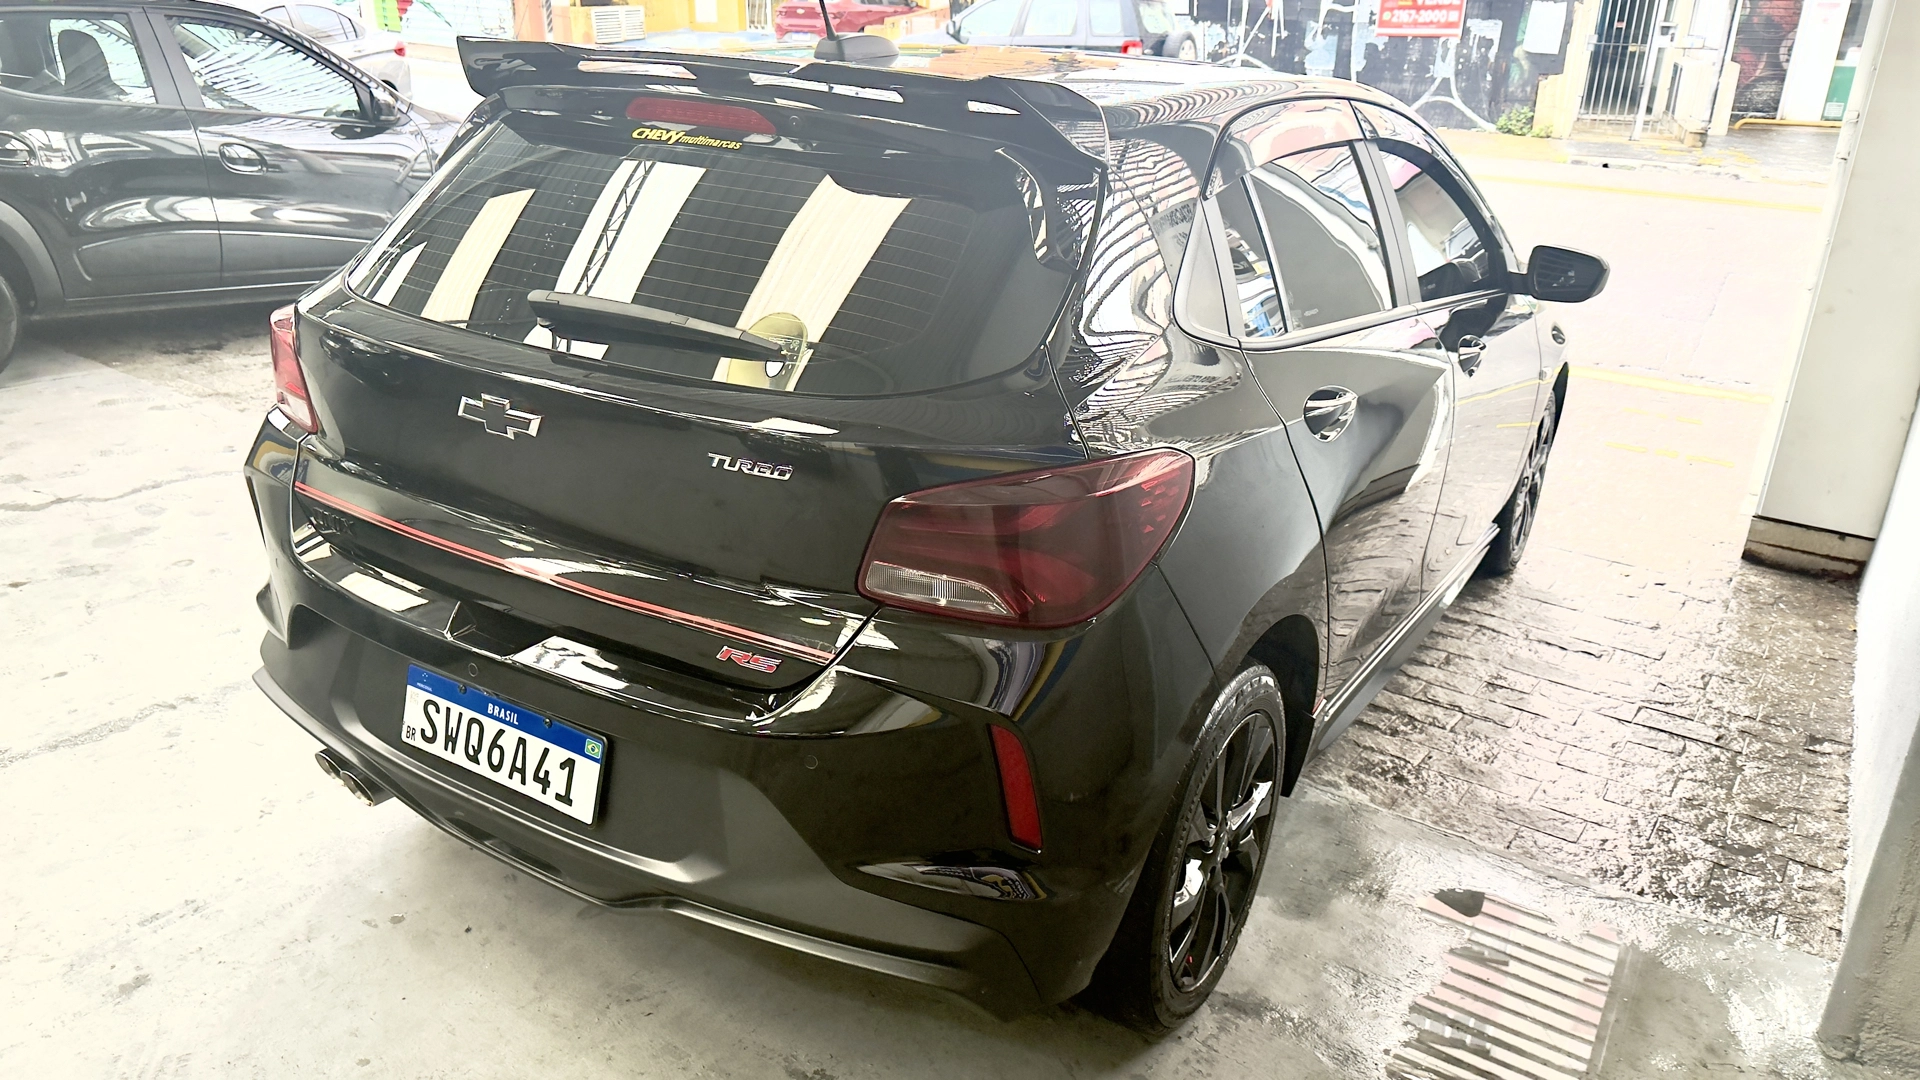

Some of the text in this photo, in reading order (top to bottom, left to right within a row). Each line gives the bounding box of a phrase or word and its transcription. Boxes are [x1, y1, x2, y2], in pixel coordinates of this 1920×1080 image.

[631, 127, 743, 150] CHEVY multimarcas
[707, 452, 793, 480] TURBO
[716, 645, 782, 673] RS
[487, 702, 519, 725] BRASIL
[406, 724, 417, 741] BR
[420, 699, 576, 807] SWQ6A41
